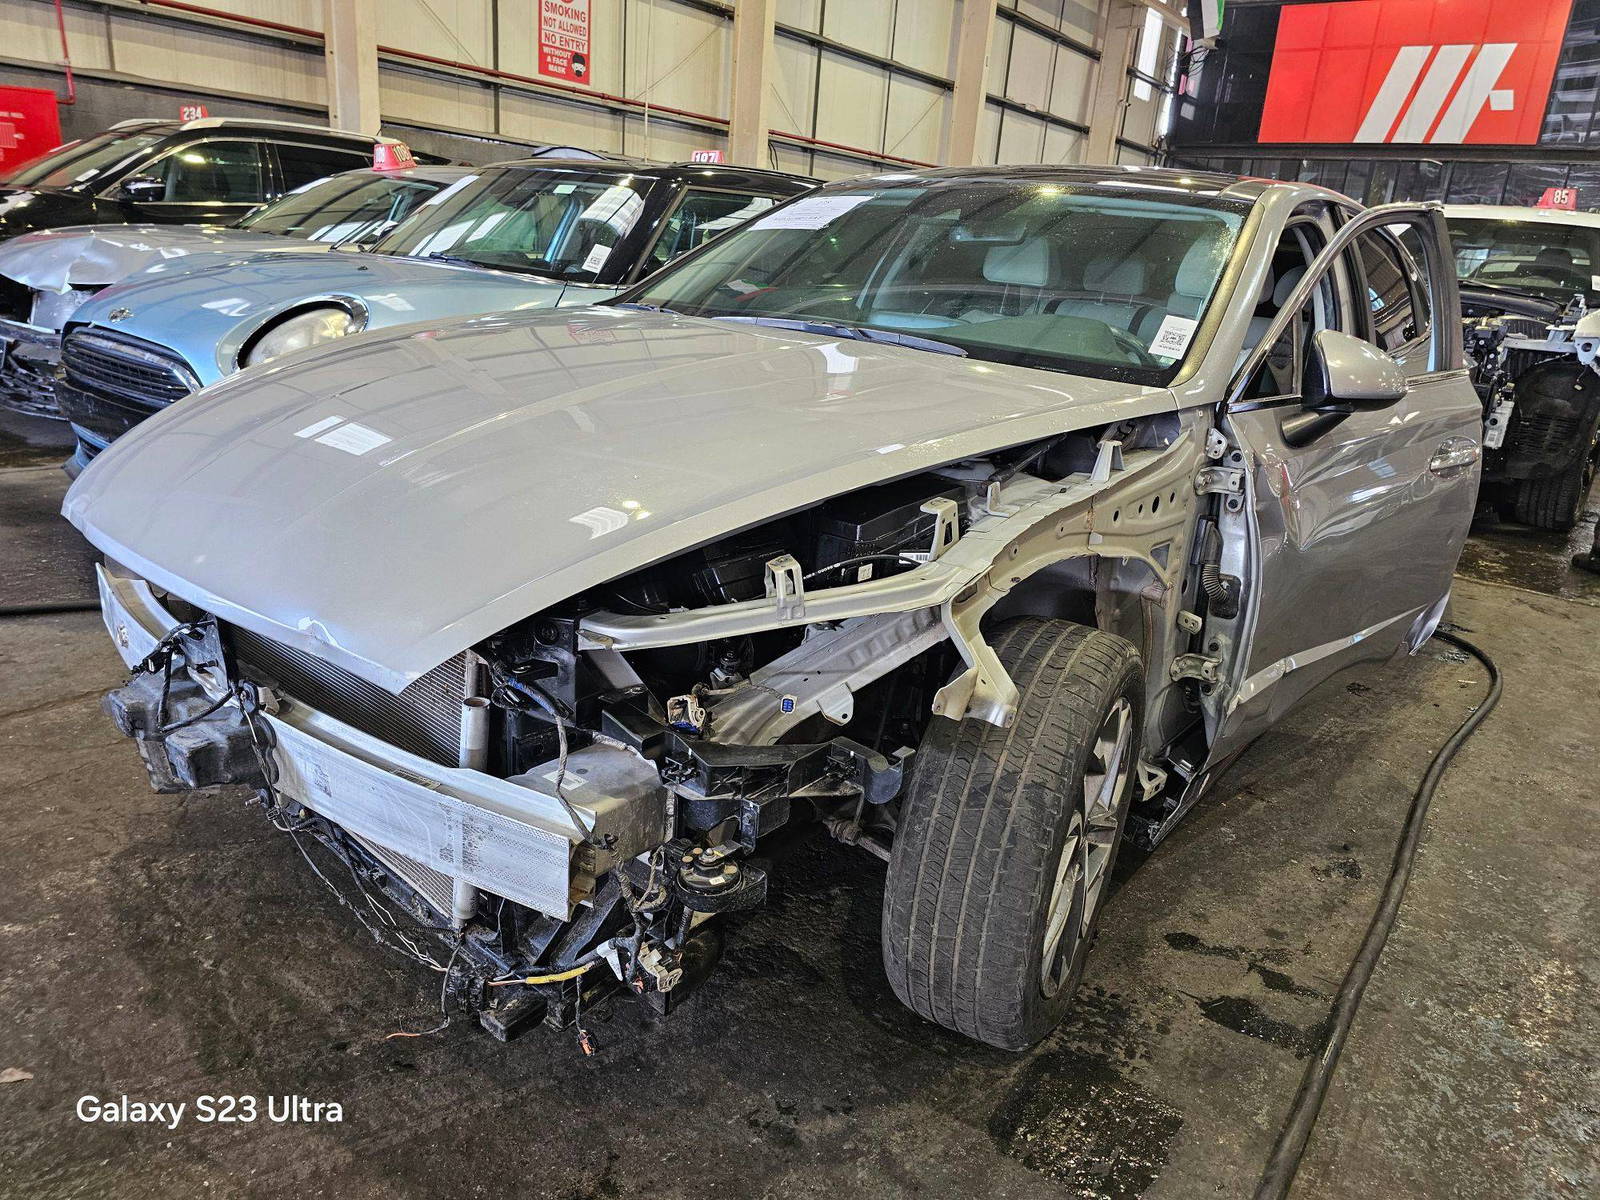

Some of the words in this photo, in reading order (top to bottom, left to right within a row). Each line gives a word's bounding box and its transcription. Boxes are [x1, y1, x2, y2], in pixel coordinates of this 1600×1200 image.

[544, 1, 586, 22] SMOKING
[543, 15, 556, 29] NOT
[558, 20, 587, 37] ALLOWED
[544, 31, 557, 45] NO
[559, 36, 586, 51] ENTRY
[543, 46, 571, 58] WITHOUT
[552, 56, 568, 67] FACE
[548, 63, 566, 75] MASK
[183, 106, 202, 120] 234
[1553, 189, 1569, 204] 85
